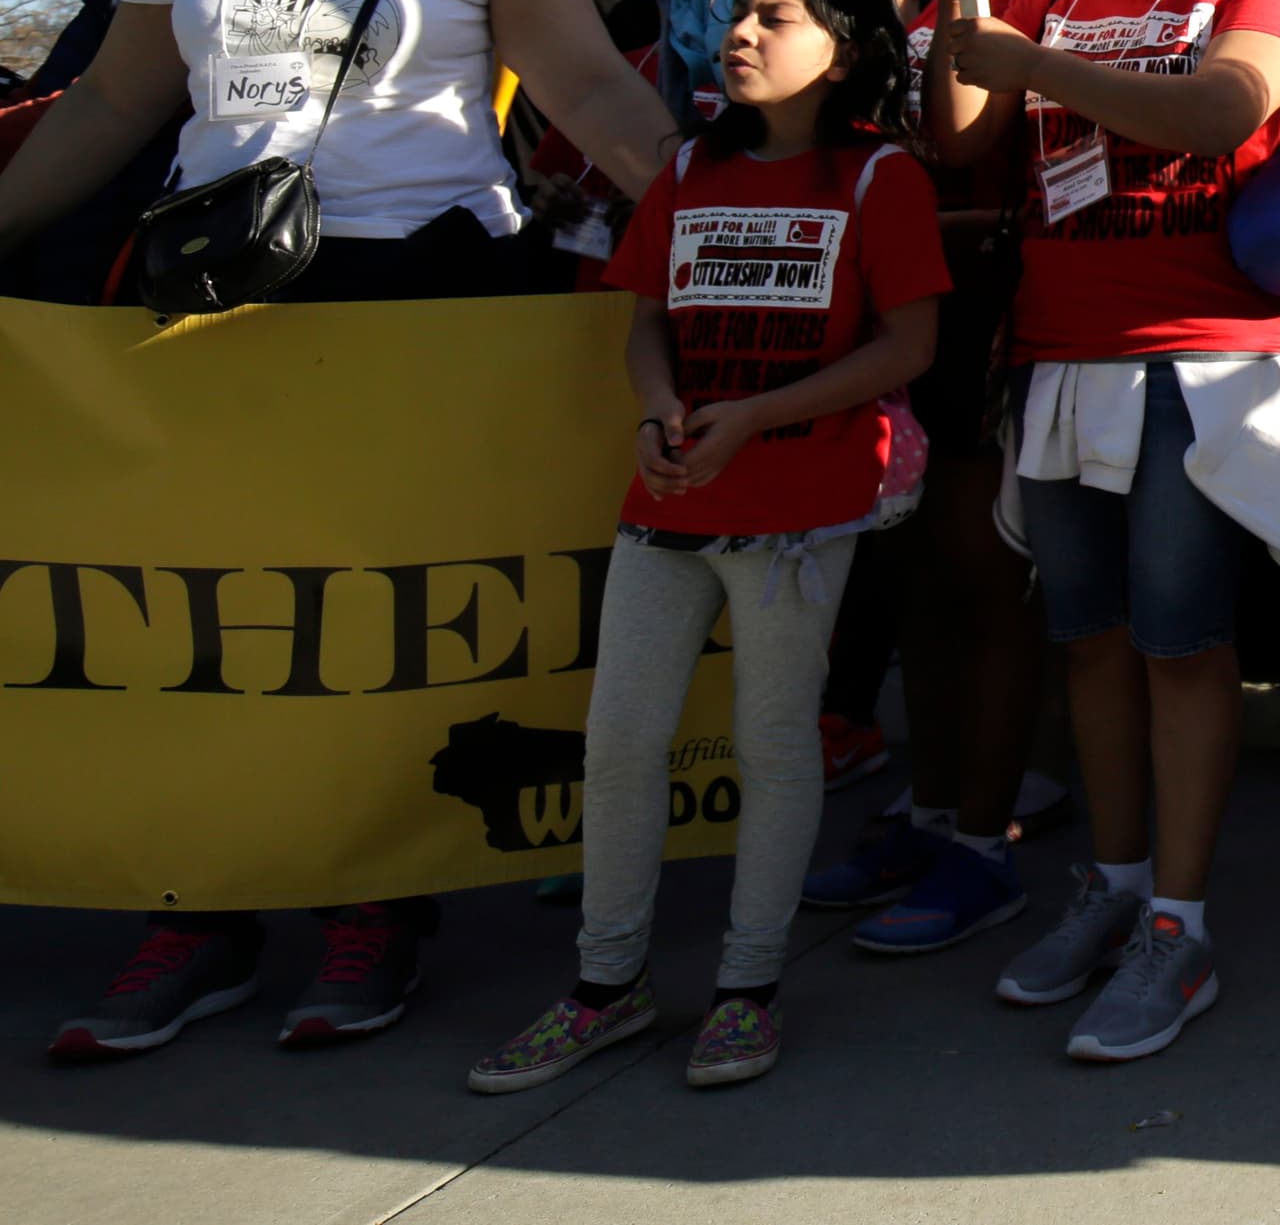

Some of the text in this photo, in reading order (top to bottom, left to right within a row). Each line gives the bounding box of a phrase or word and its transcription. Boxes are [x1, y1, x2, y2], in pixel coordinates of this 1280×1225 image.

[227, 76, 306, 107] Norys
[689, 221, 718, 234] DREAM
[721, 221, 743, 233] FOR
[716, 234, 739, 245] MORE
[693, 262, 820, 288] CITIZENSHIP NOW!
